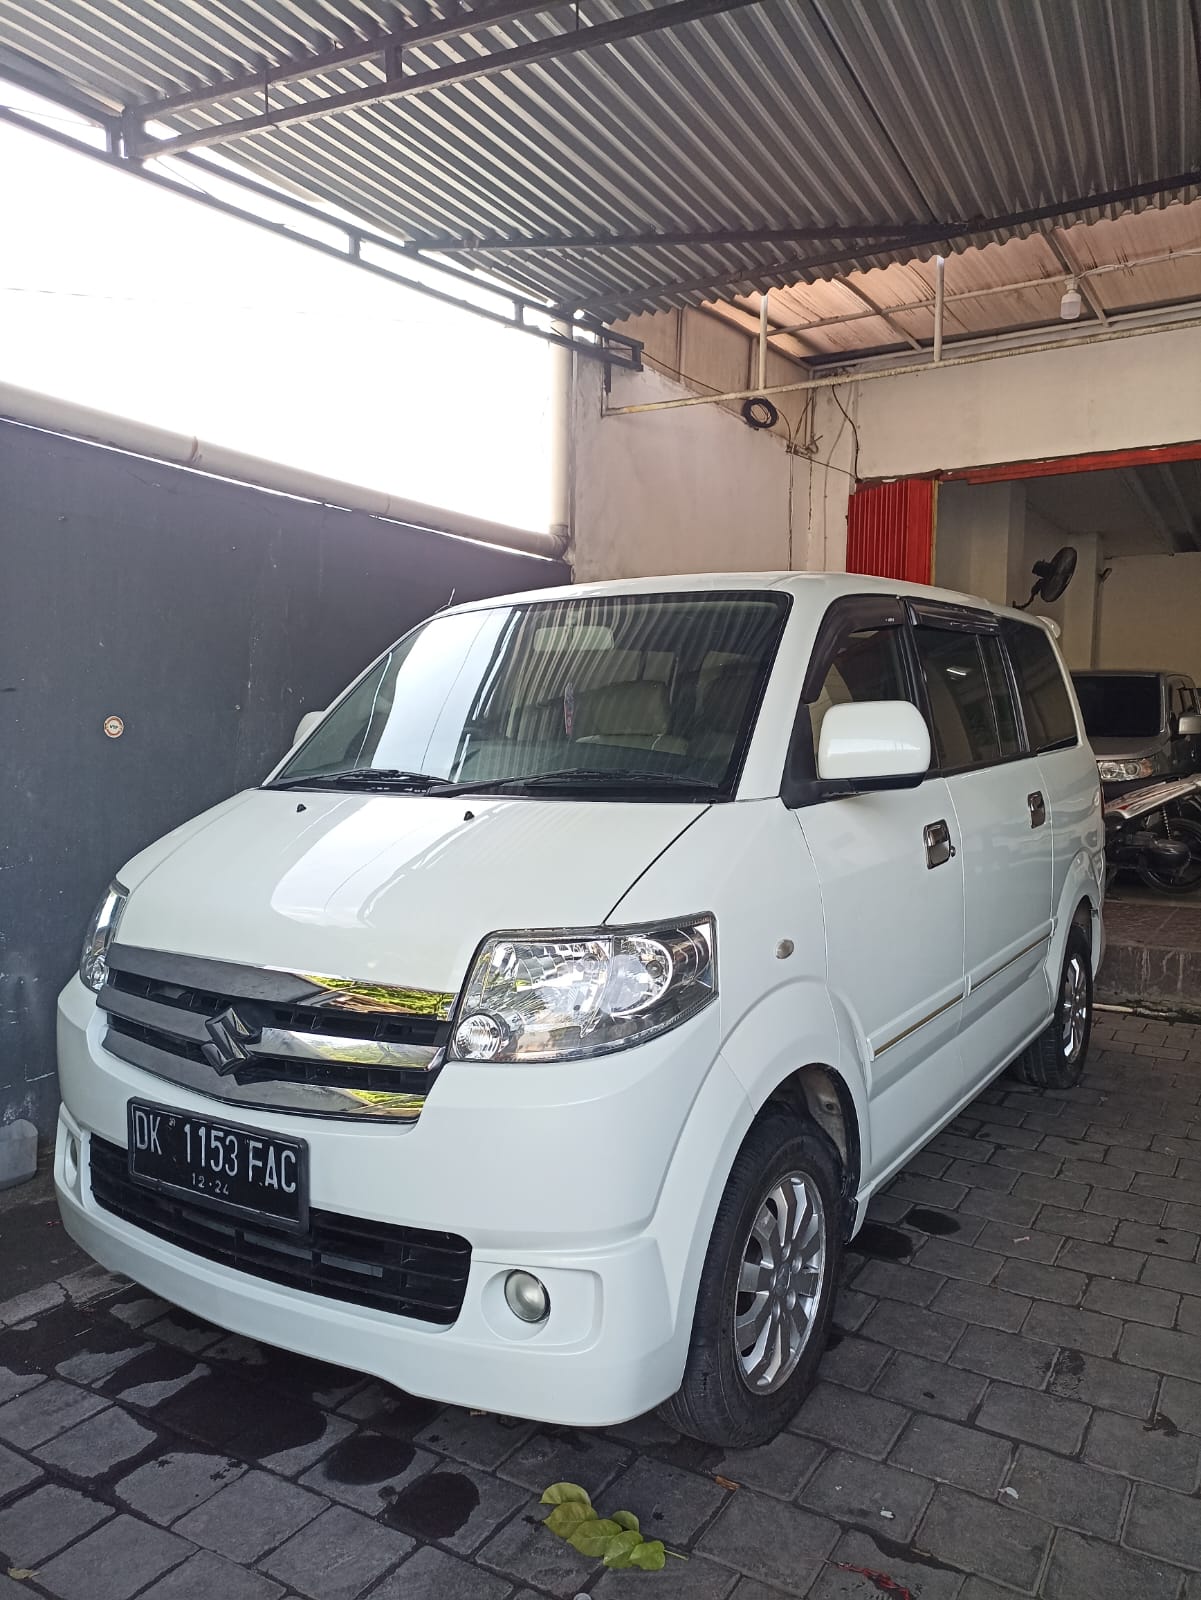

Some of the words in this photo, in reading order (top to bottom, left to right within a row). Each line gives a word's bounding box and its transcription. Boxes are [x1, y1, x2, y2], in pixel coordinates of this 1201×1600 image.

[135, 1110, 162, 1155] DK
[184, 1123, 238, 1177] 1153
[248, 1140, 296, 1193] FAC
